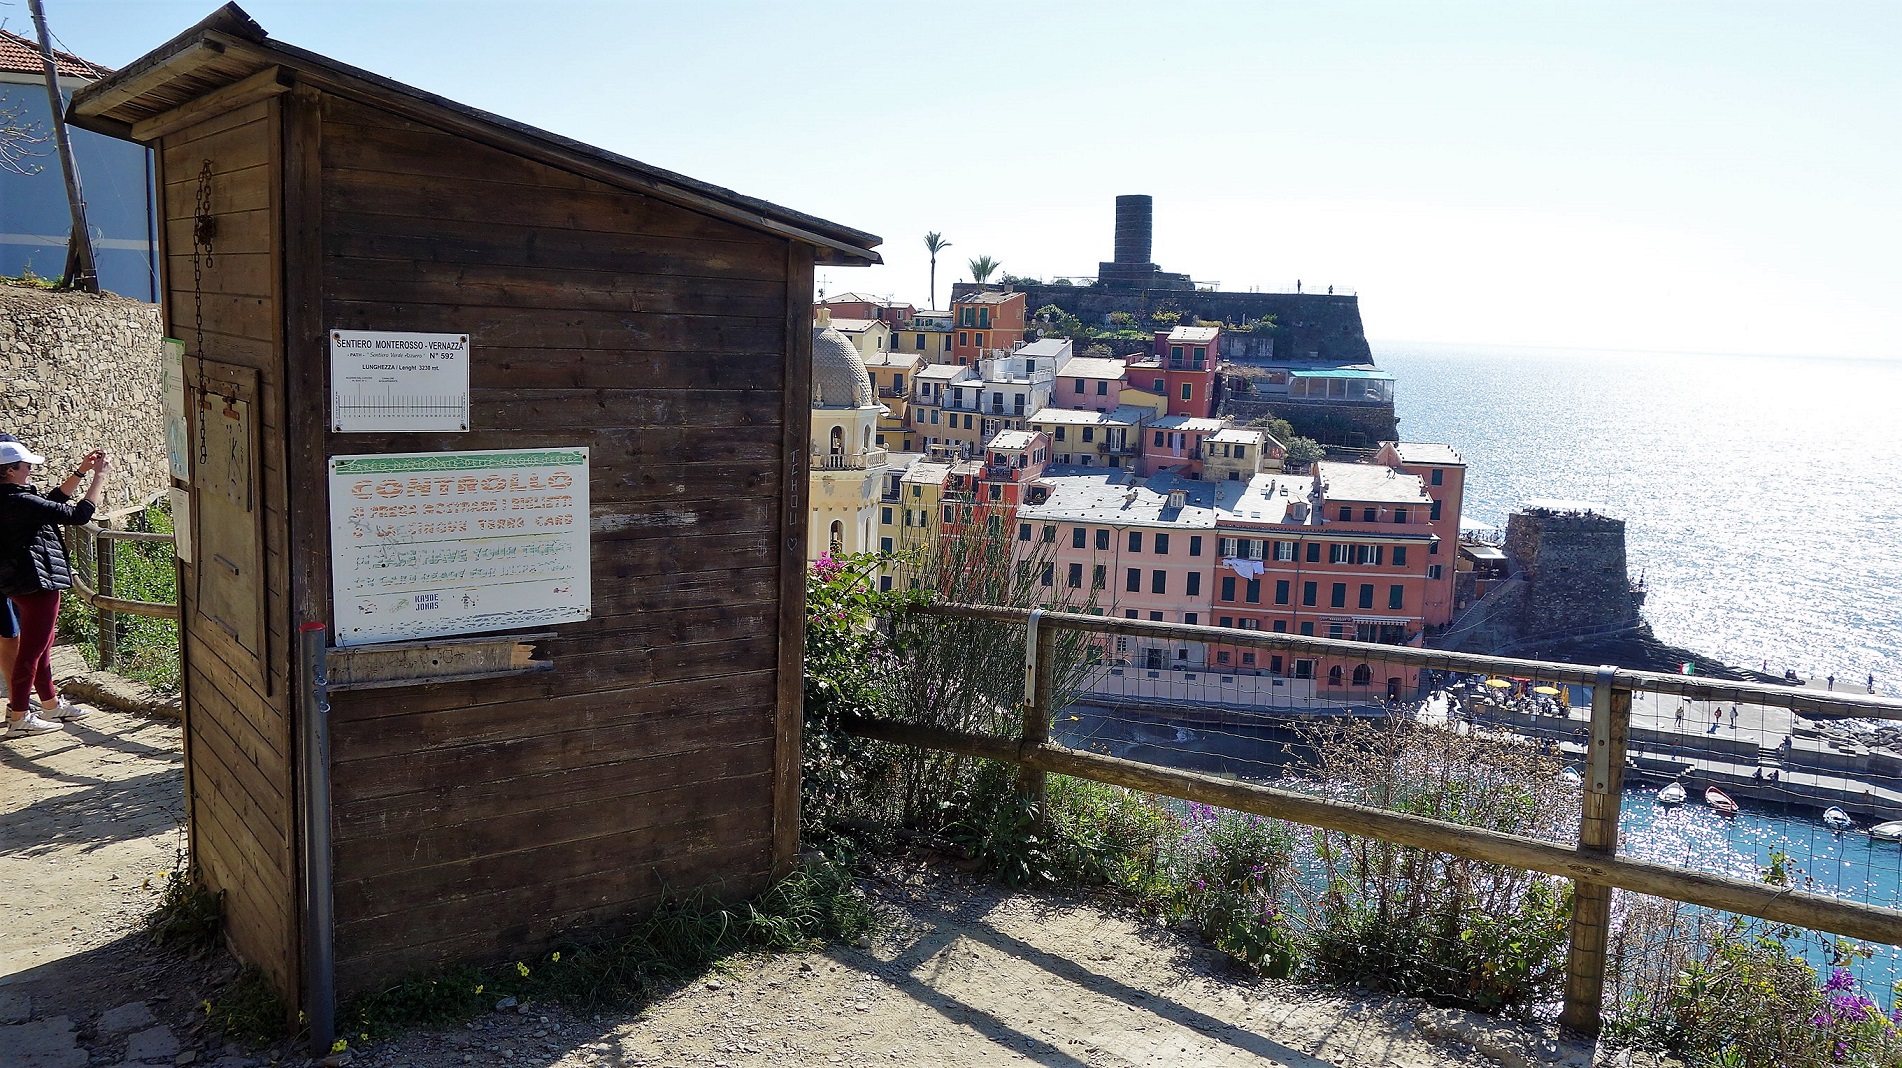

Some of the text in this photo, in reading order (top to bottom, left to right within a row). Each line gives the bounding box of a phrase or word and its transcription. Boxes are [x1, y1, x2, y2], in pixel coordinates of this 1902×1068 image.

[336, 339, 372, 349] SENTIERO
[376, 341, 423, 350] MONTEROSSO
[428, 342, 464, 351] VERNAZZA
[351, 471, 573, 499] CONTROLLO
[535, 513, 574, 527] CARD
